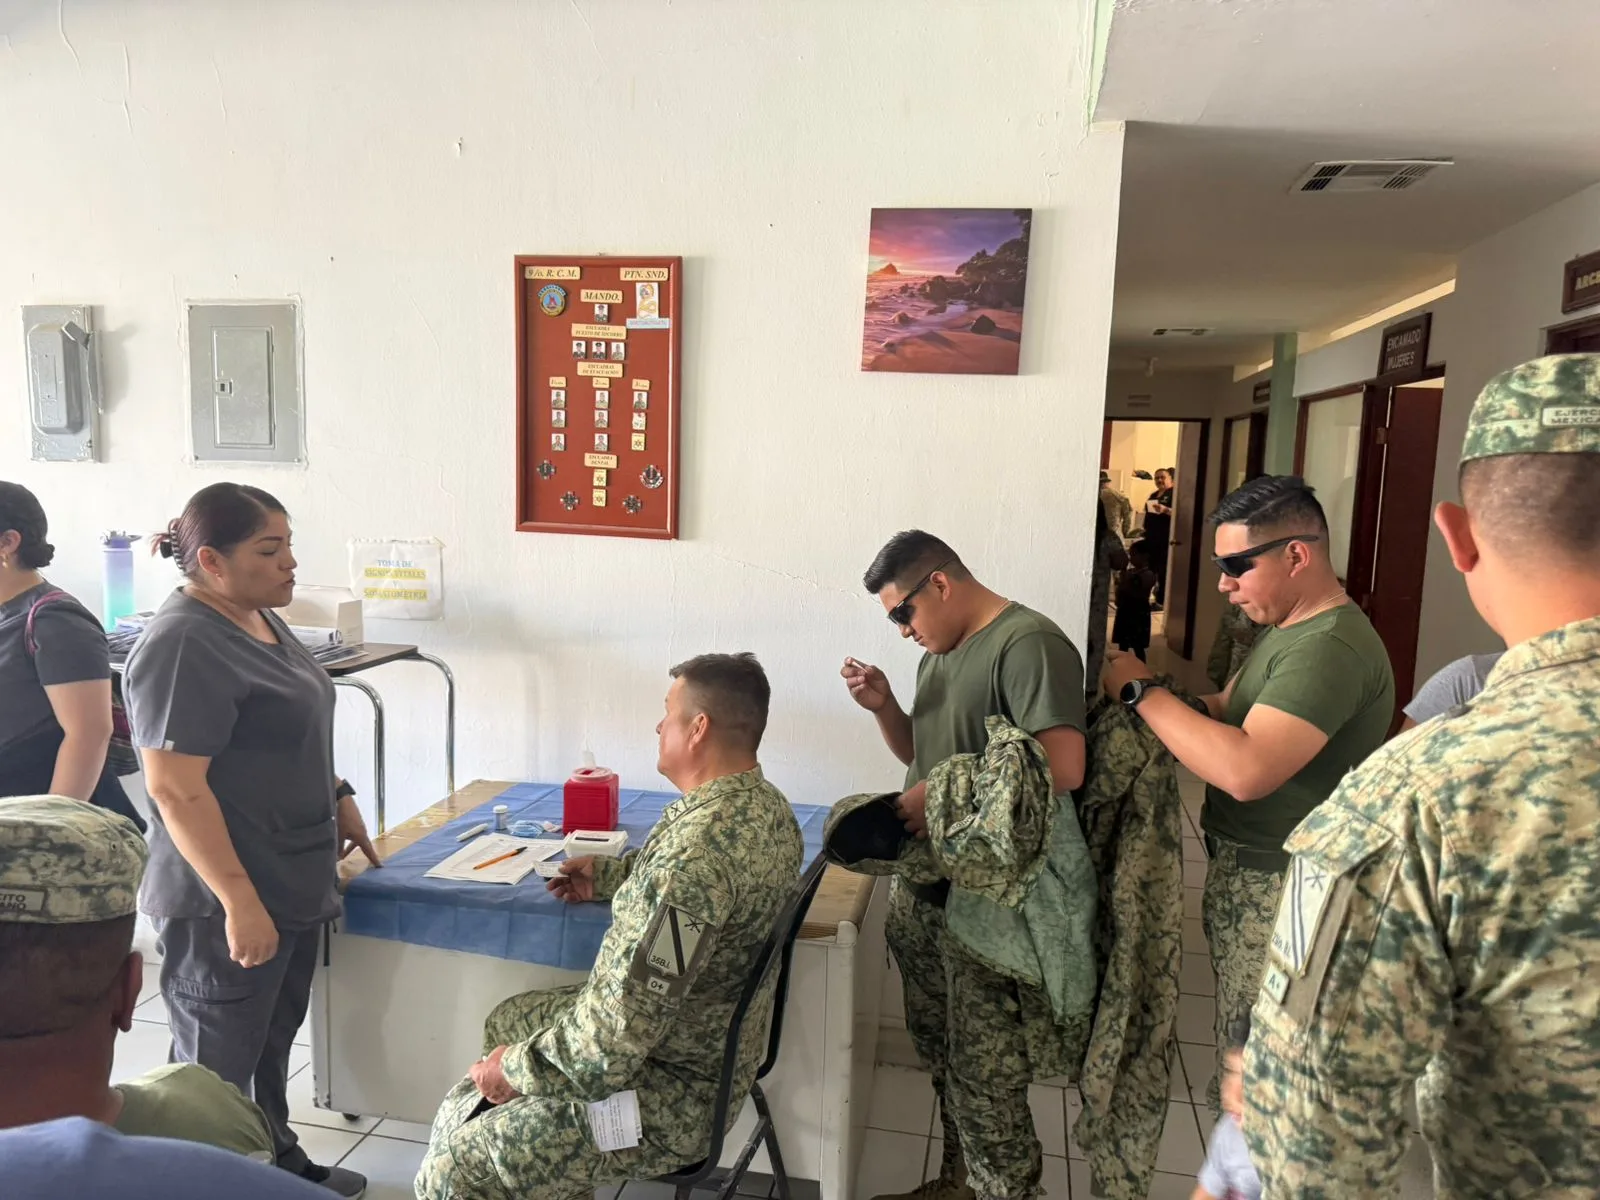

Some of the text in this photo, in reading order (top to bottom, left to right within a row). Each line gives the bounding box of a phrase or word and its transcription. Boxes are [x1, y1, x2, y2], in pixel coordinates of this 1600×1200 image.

[545, 269, 554, 278] R.
[557, 269, 565, 278] C.
[566, 269, 577, 278] M.
[624, 270, 667, 279] PTN. SND.
[584, 291, 620, 301] MANDO.
[1387, 328, 1421, 352] ENCAMADO
[1387, 351, 1415, 370] MUJERES
[1555, 409, 1600, 417] EJERC
